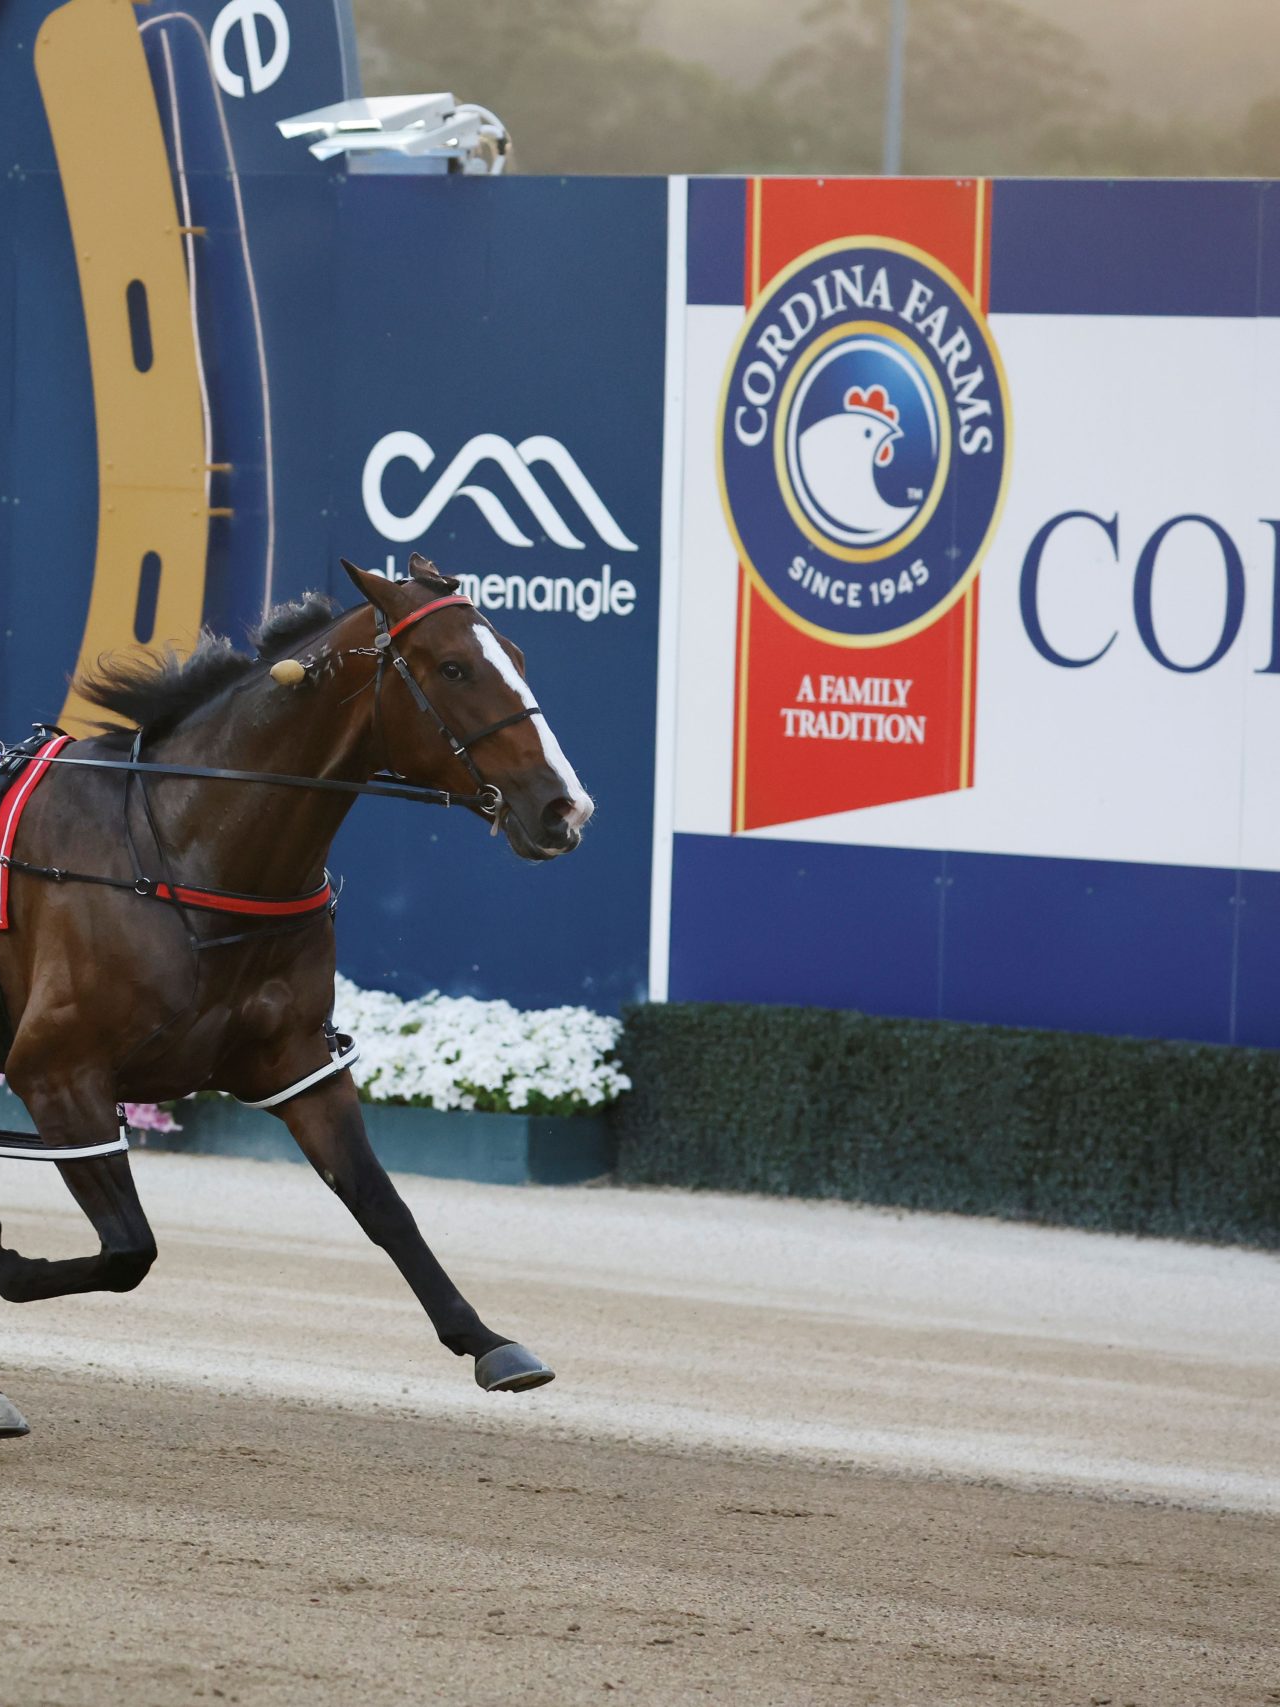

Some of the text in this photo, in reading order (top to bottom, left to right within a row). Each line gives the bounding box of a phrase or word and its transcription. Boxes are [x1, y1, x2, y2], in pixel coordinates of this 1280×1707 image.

[734, 264, 993, 456] CORDINA FARMS
[457, 563, 637, 622] menangle
[787, 555, 930, 608] SINCE 1945
[1018, 509, 1280, 674] CO
[795, 674, 913, 708] A FAMILY
[779, 708, 927, 744] TRADITION
